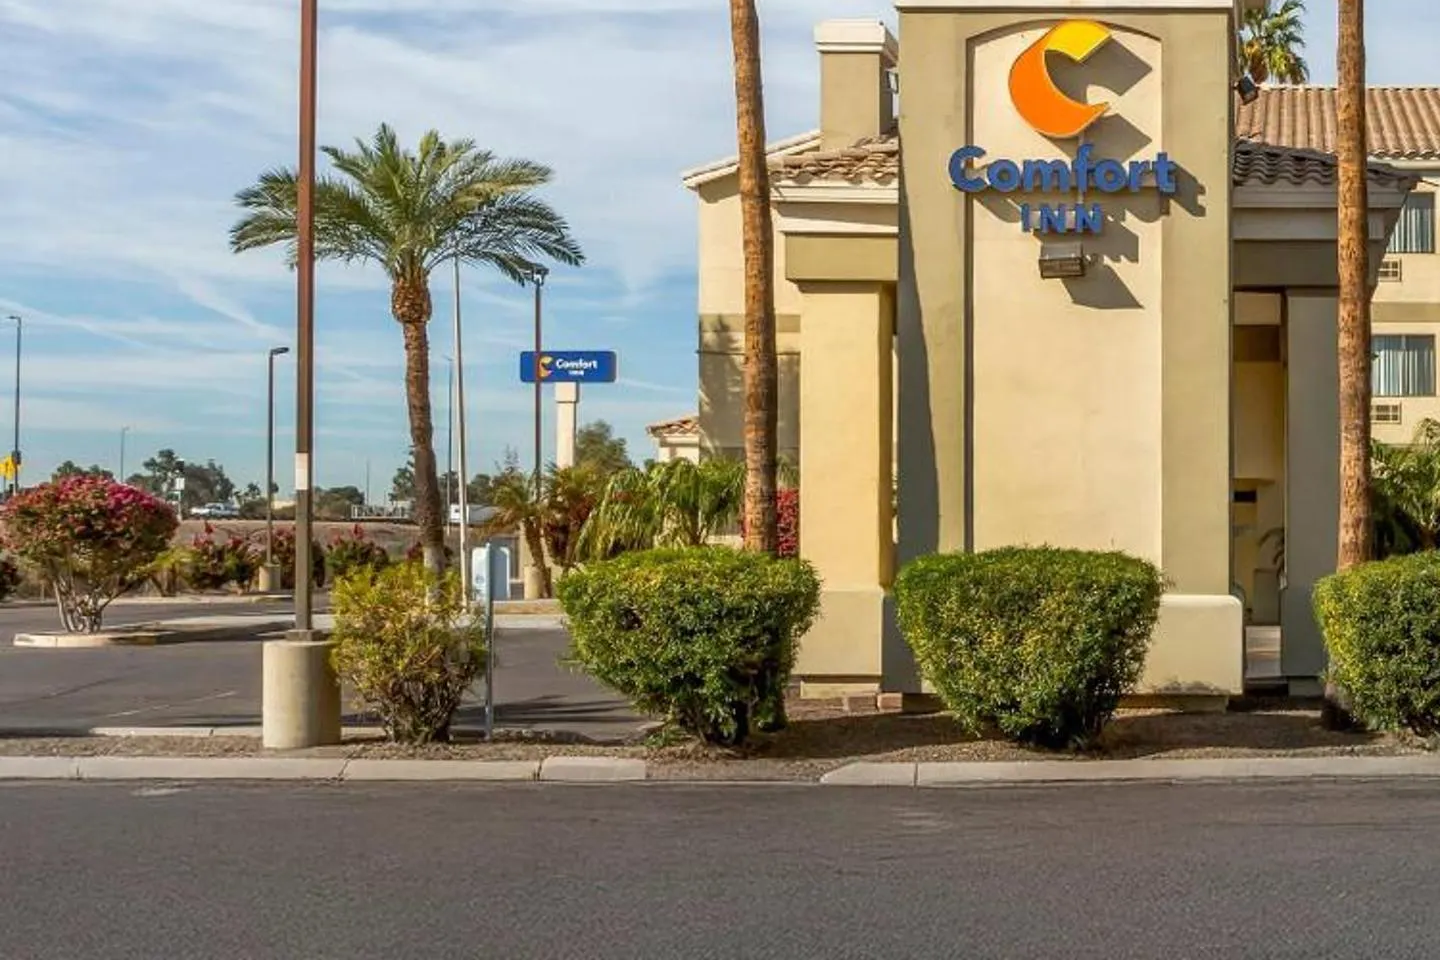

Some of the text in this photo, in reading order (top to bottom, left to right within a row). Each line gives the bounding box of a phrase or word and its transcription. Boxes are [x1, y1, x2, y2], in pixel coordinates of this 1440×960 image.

[948, 143, 1177, 193] Comfort
[1020, 202, 1104, 234] INN
[555, 357, 598, 369] Comfort
